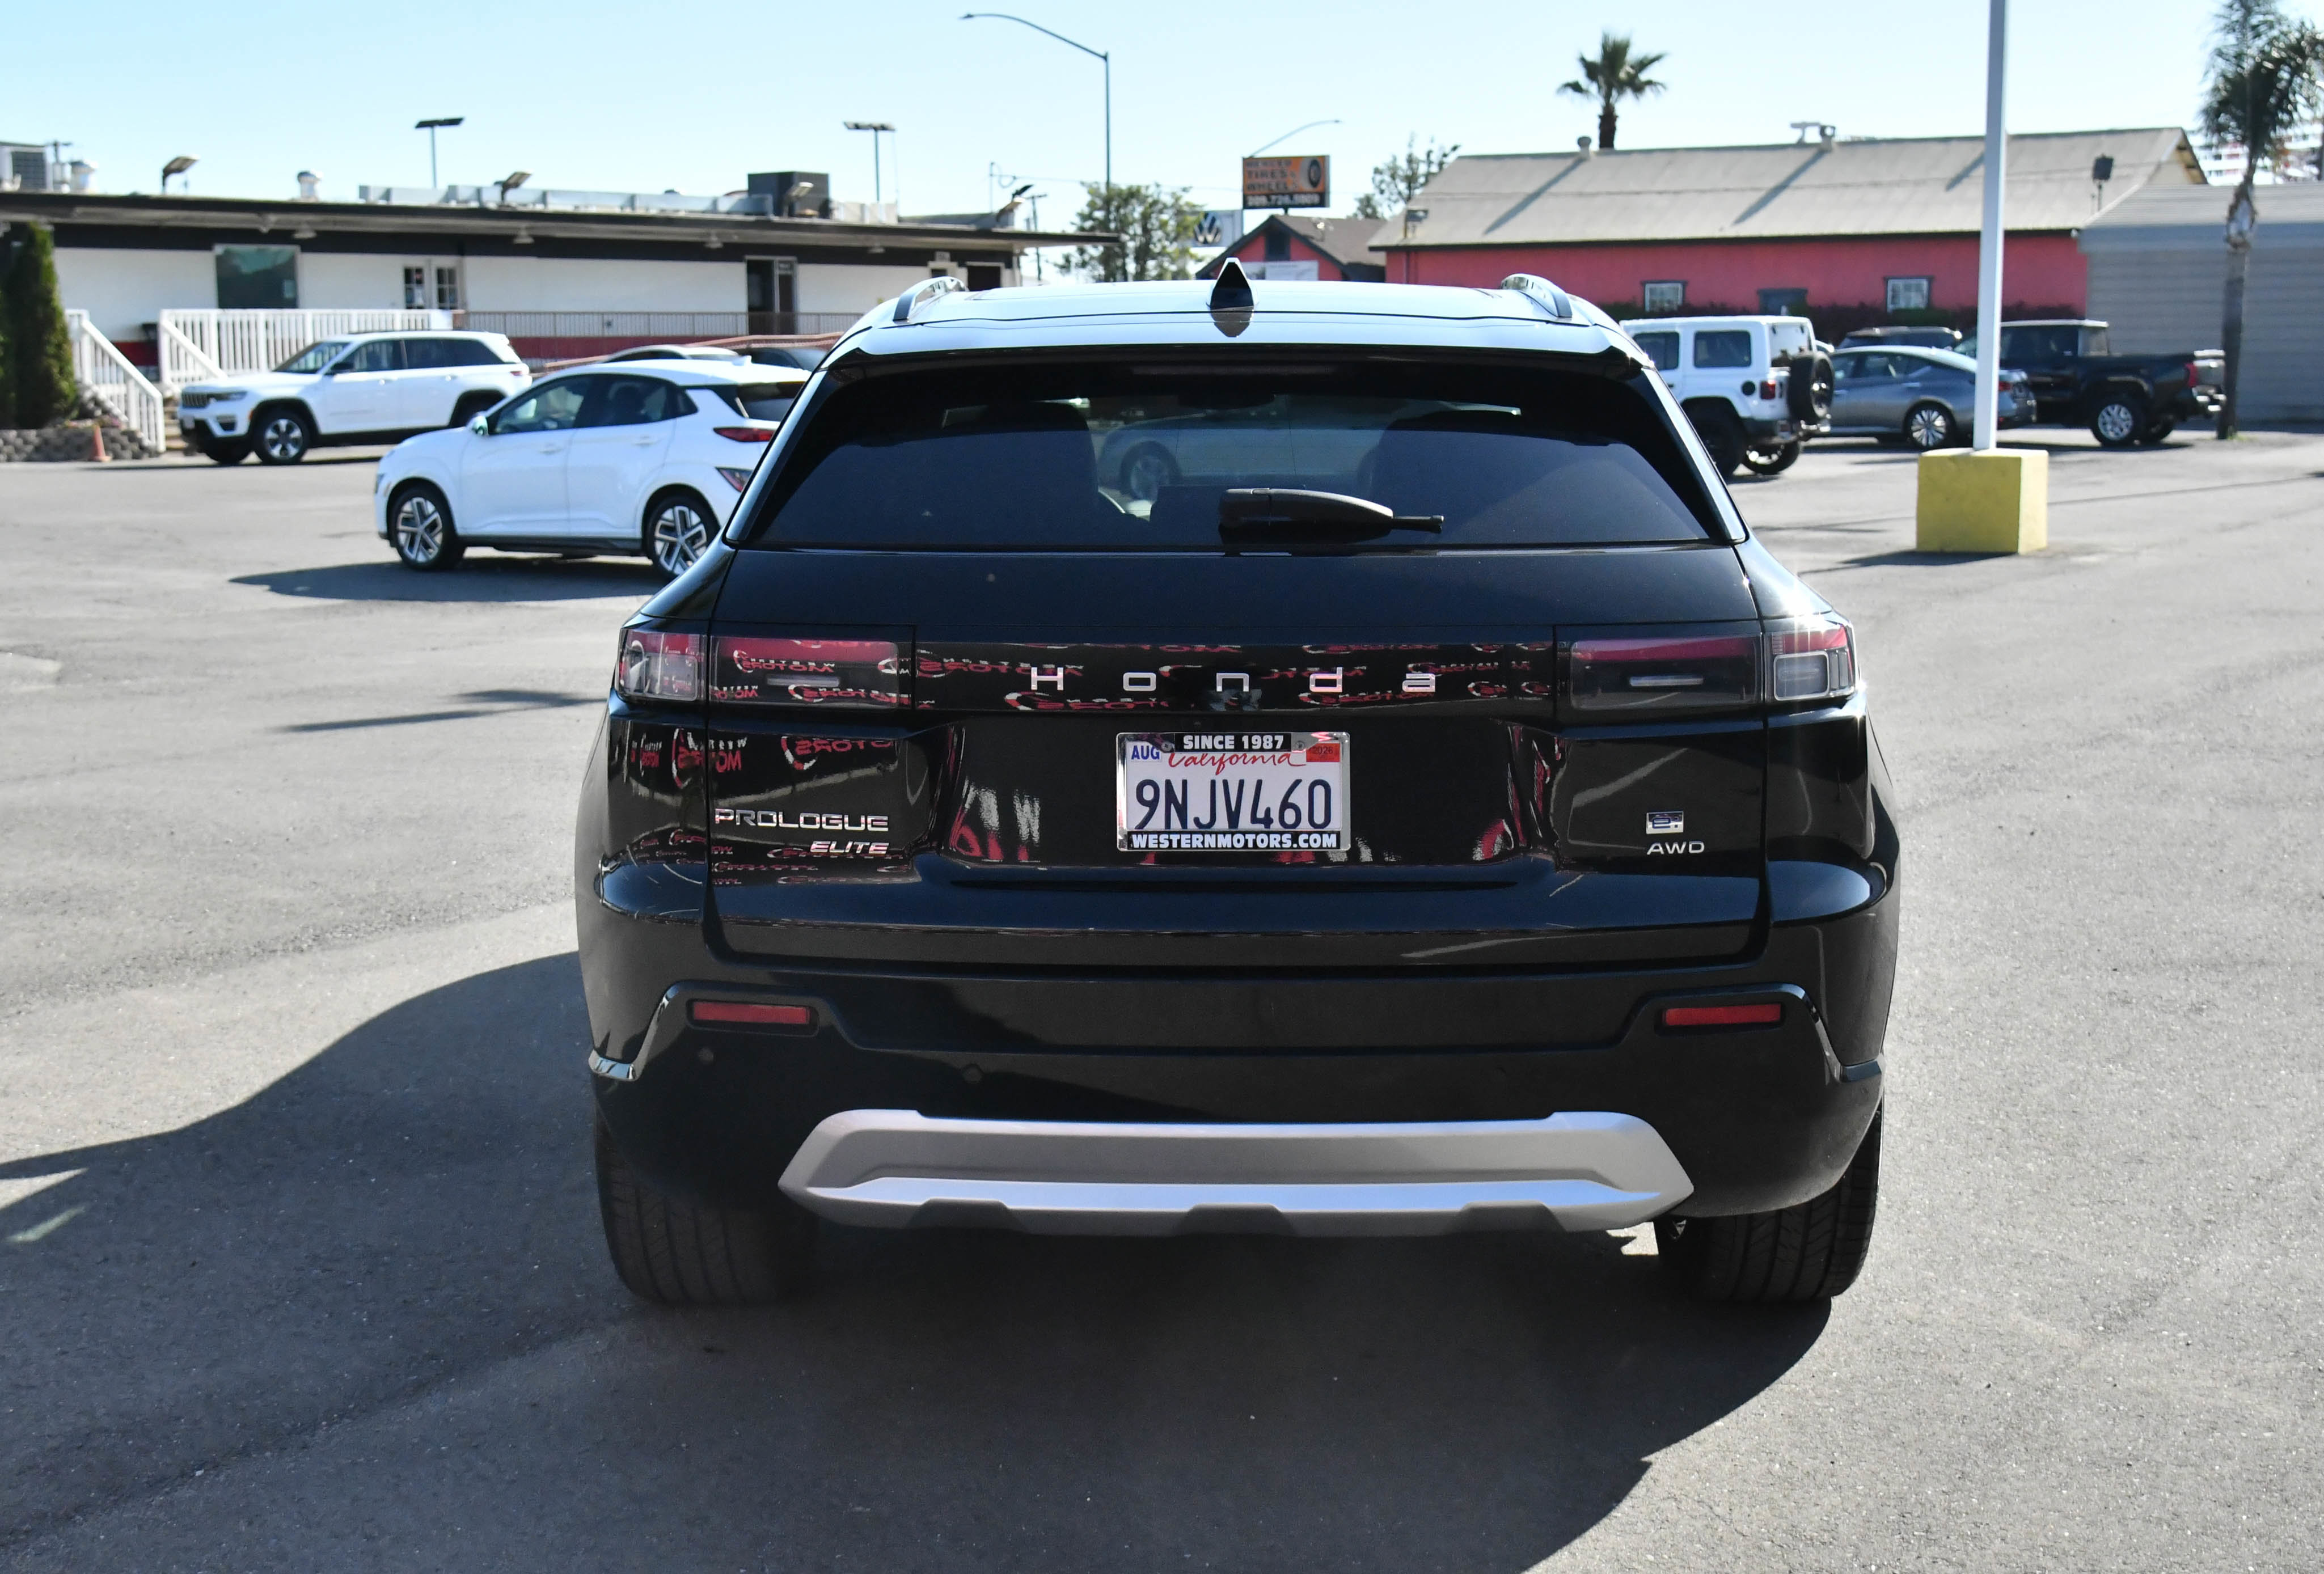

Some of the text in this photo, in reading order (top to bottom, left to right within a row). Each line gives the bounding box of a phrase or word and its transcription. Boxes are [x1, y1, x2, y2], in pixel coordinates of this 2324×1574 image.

[1183, 735, 1284, 750] SINCE 1987
[1131, 745, 1160, 760] AUG
[1135, 779, 1332, 830] 9NJV460
[715, 809, 889, 831] PROLOGUE
[810, 841, 889, 854] ELITE
[1133, 833, 1337, 849] WESTERNMOTORS.COM
[1647, 841, 1705, 855] AWD
